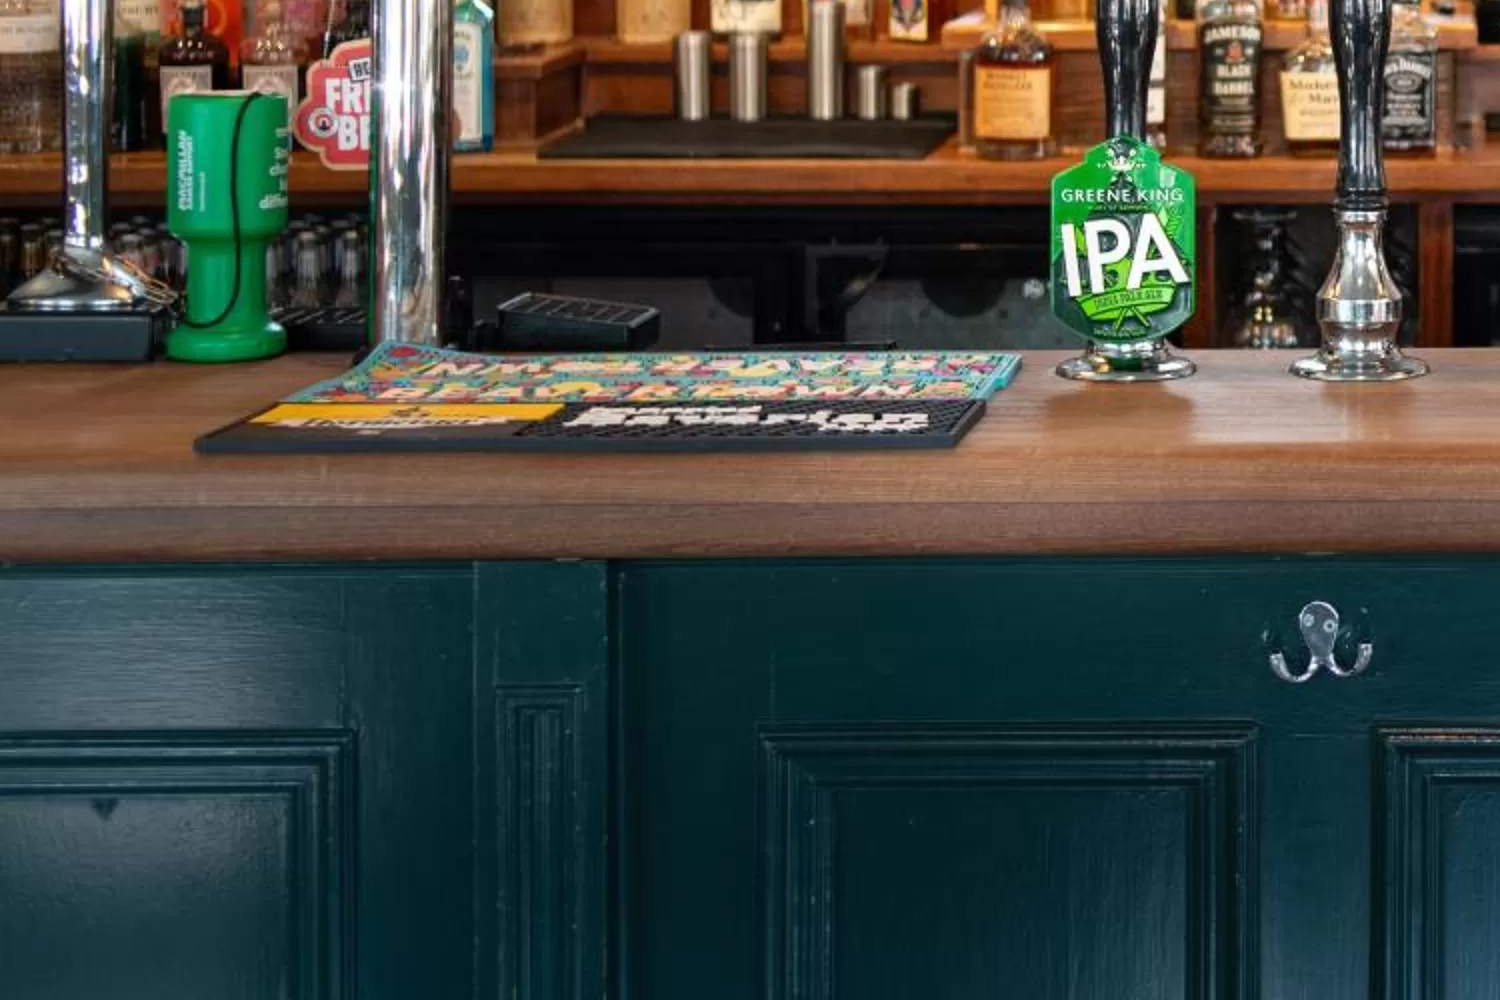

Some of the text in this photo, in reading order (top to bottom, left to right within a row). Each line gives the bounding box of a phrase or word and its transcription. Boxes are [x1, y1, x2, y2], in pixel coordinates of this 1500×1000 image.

[1204, 25, 1261, 44] JAMESON
[1061, 188, 1184, 203] GREENE KING
[1061, 212, 1191, 298] IPA
